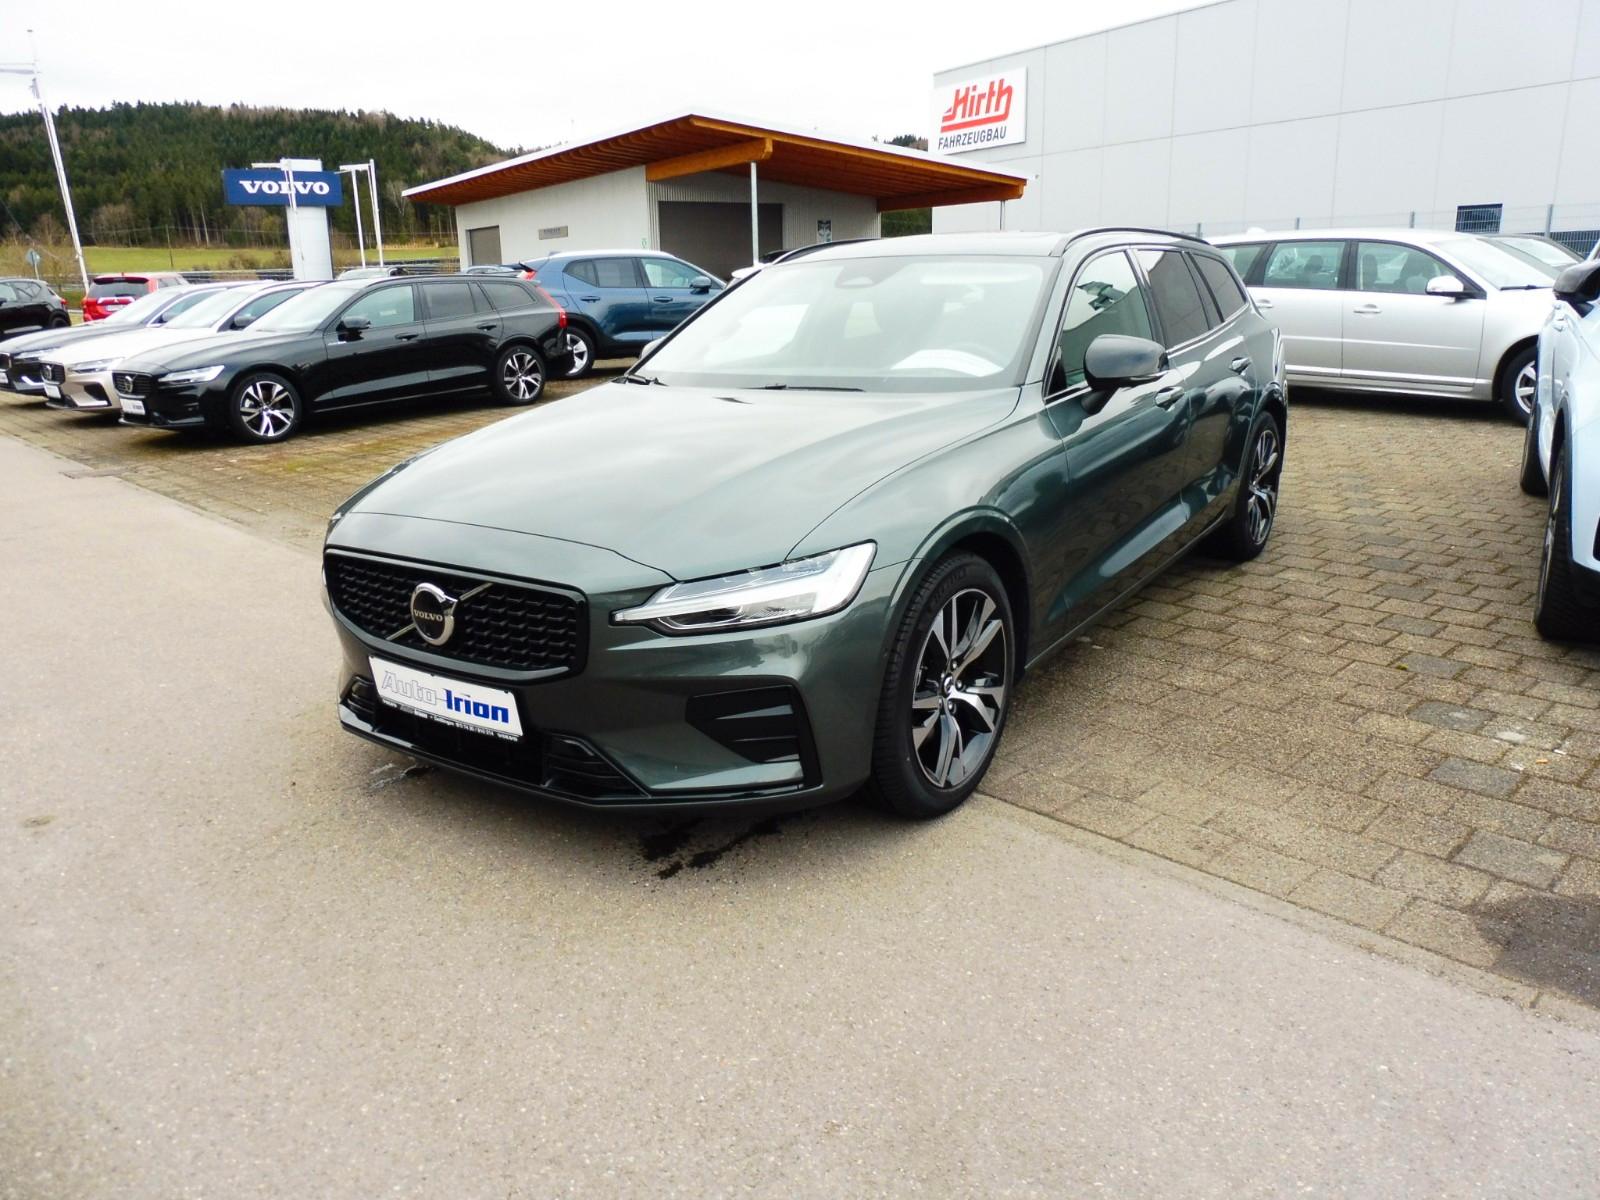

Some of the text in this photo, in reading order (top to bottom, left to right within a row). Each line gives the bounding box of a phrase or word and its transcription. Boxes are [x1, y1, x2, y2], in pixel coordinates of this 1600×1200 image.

[942, 78, 1013, 123] Hirth
[938, 126, 1007, 149] FAHRZEUGBAU
[413, 609, 443, 622] VOLVO
[382, 670, 436, 706] Auto
[444, 688, 509, 724] Irion
